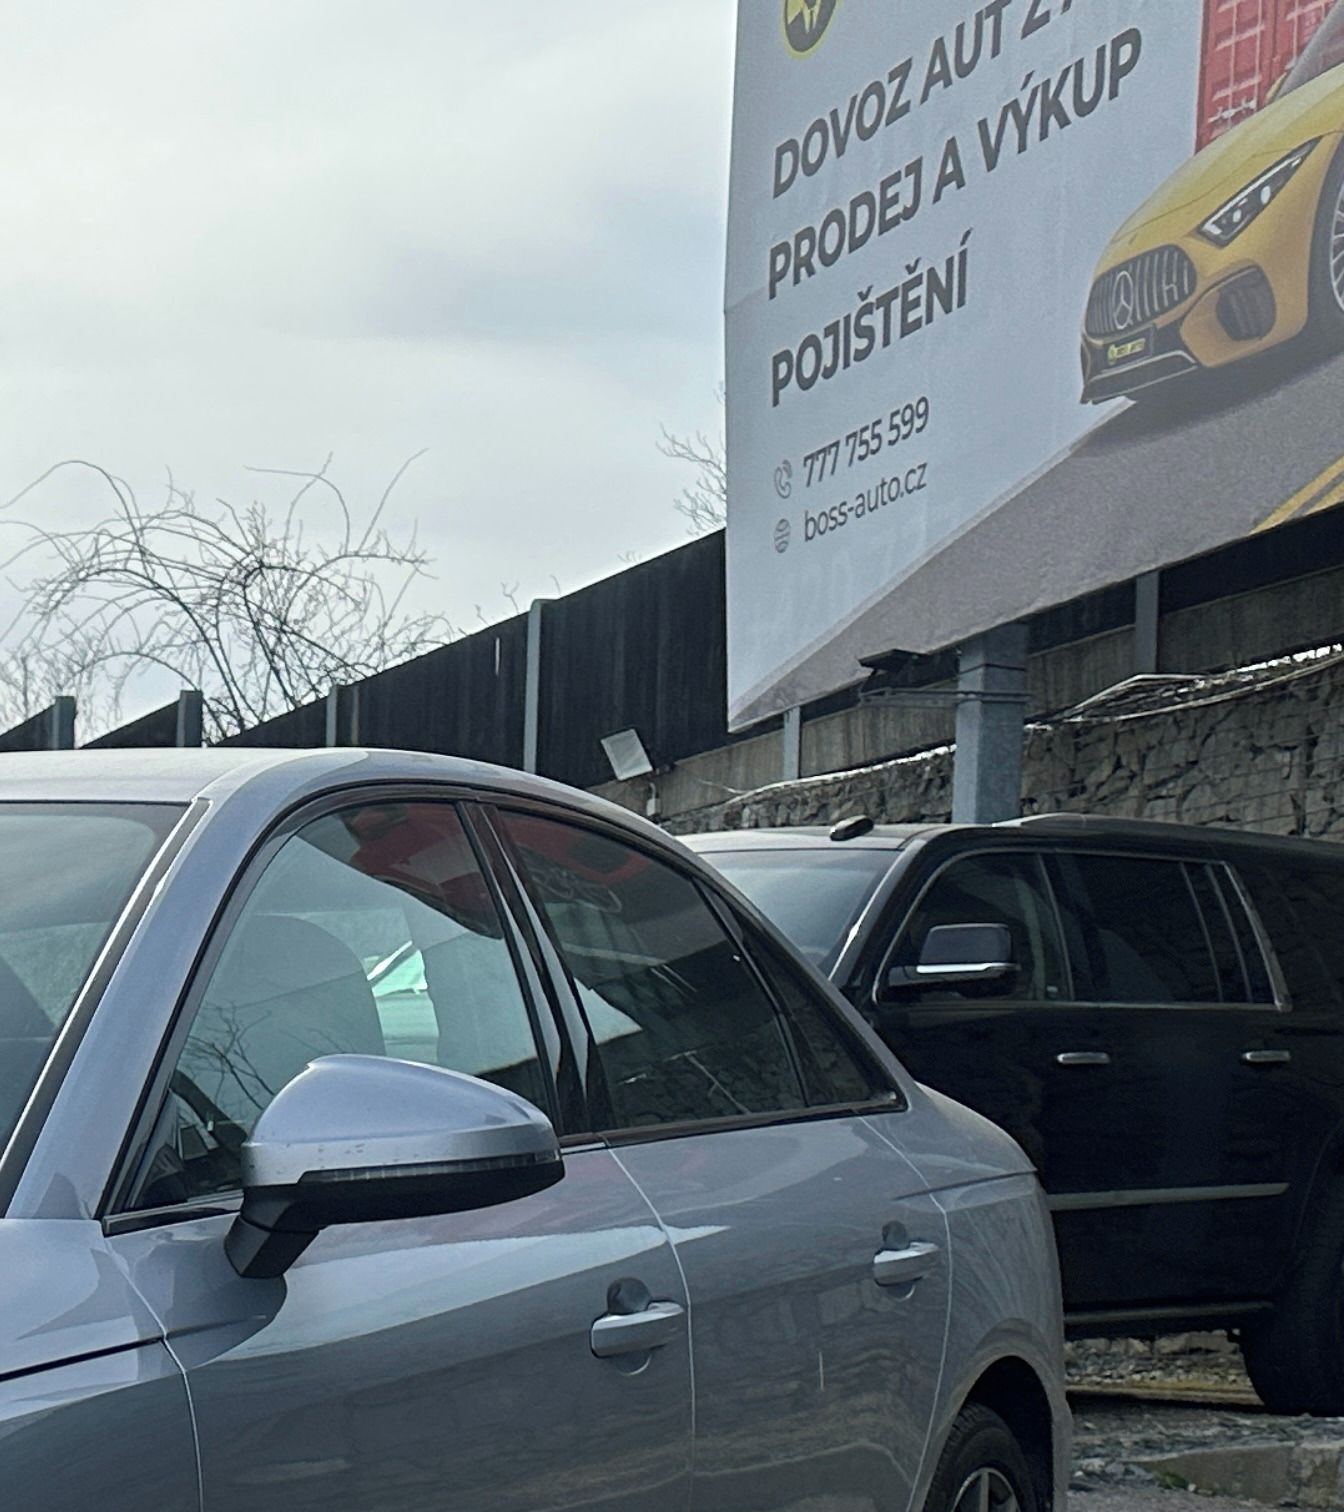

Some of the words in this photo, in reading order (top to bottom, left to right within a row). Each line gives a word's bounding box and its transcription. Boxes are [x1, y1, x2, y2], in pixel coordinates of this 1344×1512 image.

[768, 155, 924, 301] PRODEJ
[932, 136, 966, 205] A
[976, 27, 1142, 173] VÝKUP
[773, 56, 913, 200] DOVOZ
[920, 0, 1012, 105] AUT
[772, 227, 973, 408] POJIŠTĚNÍ
[803, 439, 841, 488] 777
[845, 418, 882, 467] 755
[887, 396, 930, 446] 599
[804, 462, 928, 542] boss-auto.cz
